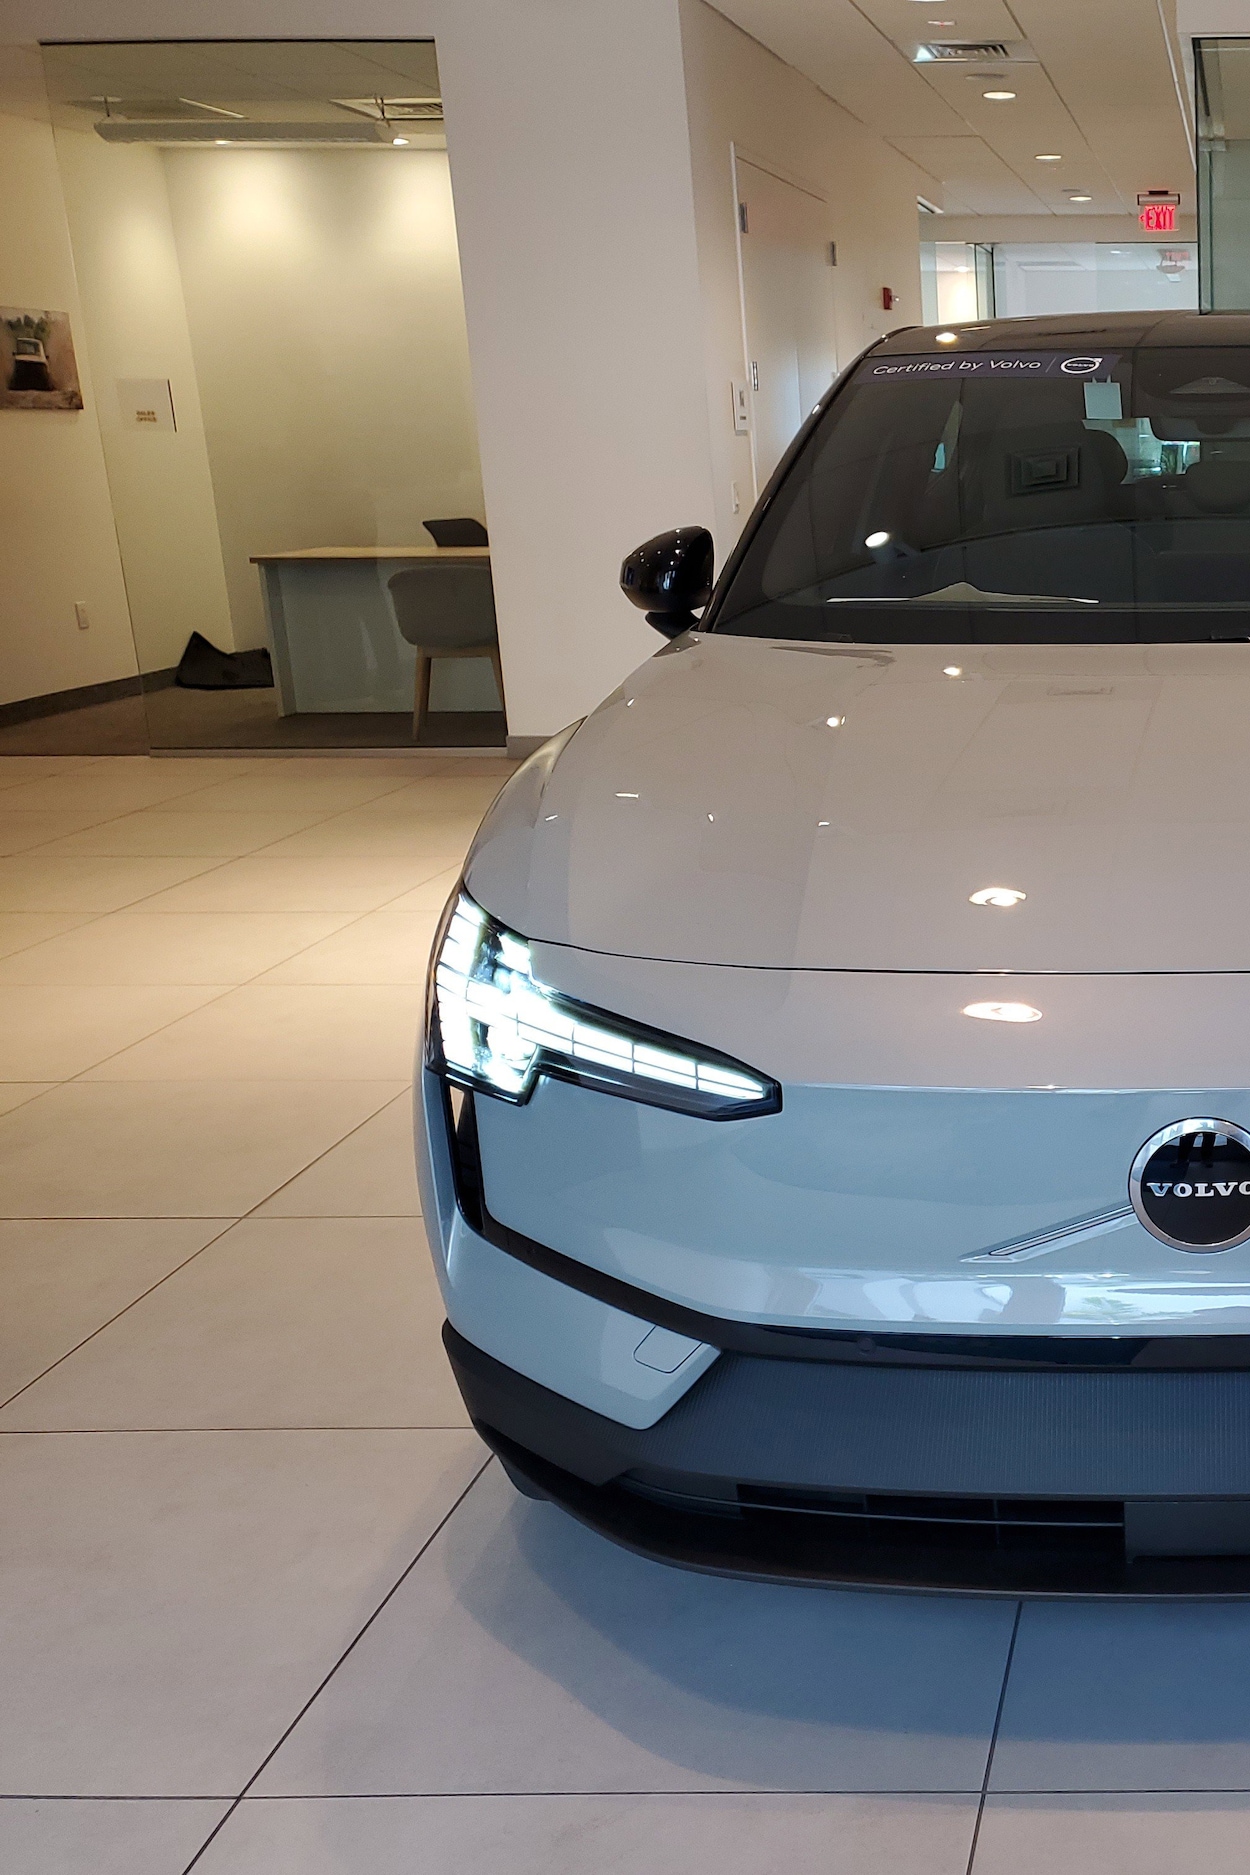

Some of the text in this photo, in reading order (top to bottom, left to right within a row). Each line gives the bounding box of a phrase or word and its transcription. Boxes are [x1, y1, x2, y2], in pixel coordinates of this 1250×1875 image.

[1145, 207, 1174, 230] EXIT
[873, 360, 1042, 375] Certified by Volvo
